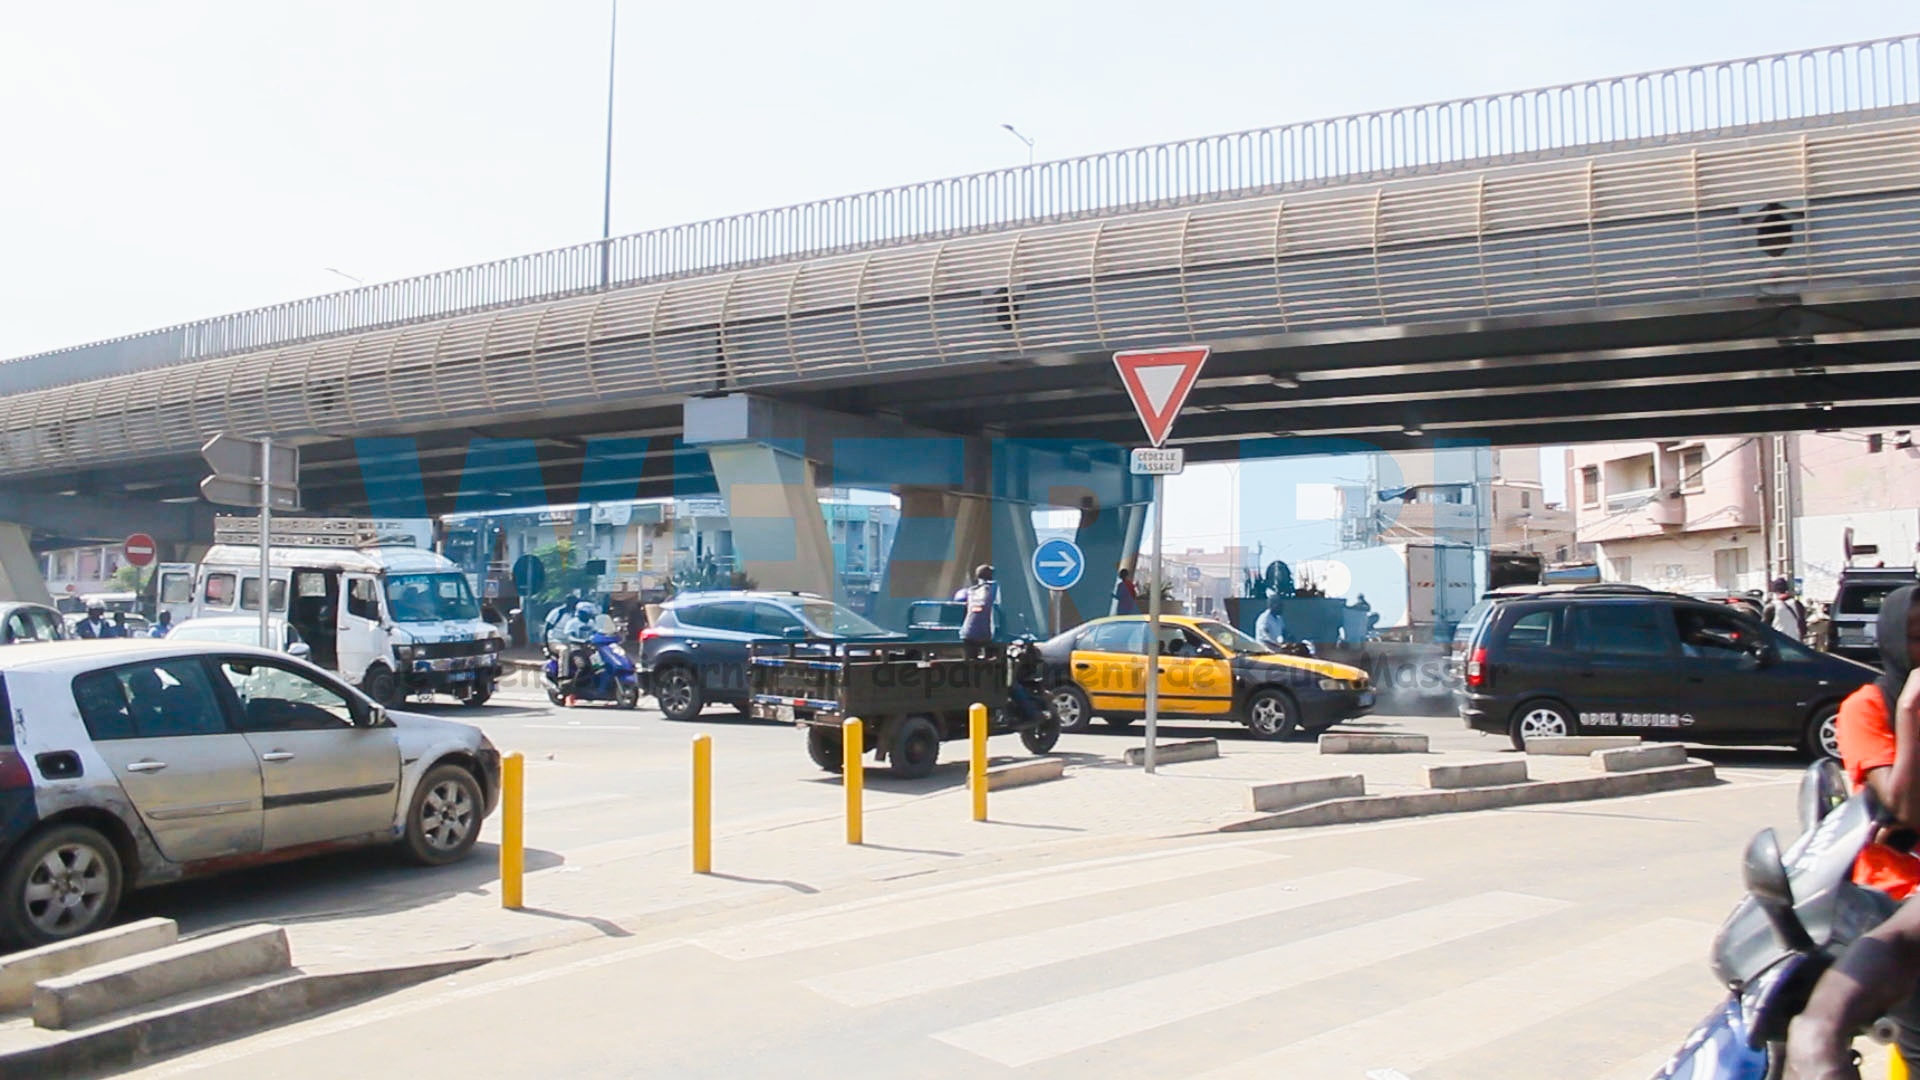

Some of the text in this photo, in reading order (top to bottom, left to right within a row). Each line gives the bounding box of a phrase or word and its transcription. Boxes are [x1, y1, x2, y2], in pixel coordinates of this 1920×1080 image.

[1166, 452, 1176, 461] LE
[1137, 462, 1176, 471] PASSAGE
[1580, 713, 1679, 727] OPEL ZAFIRA
